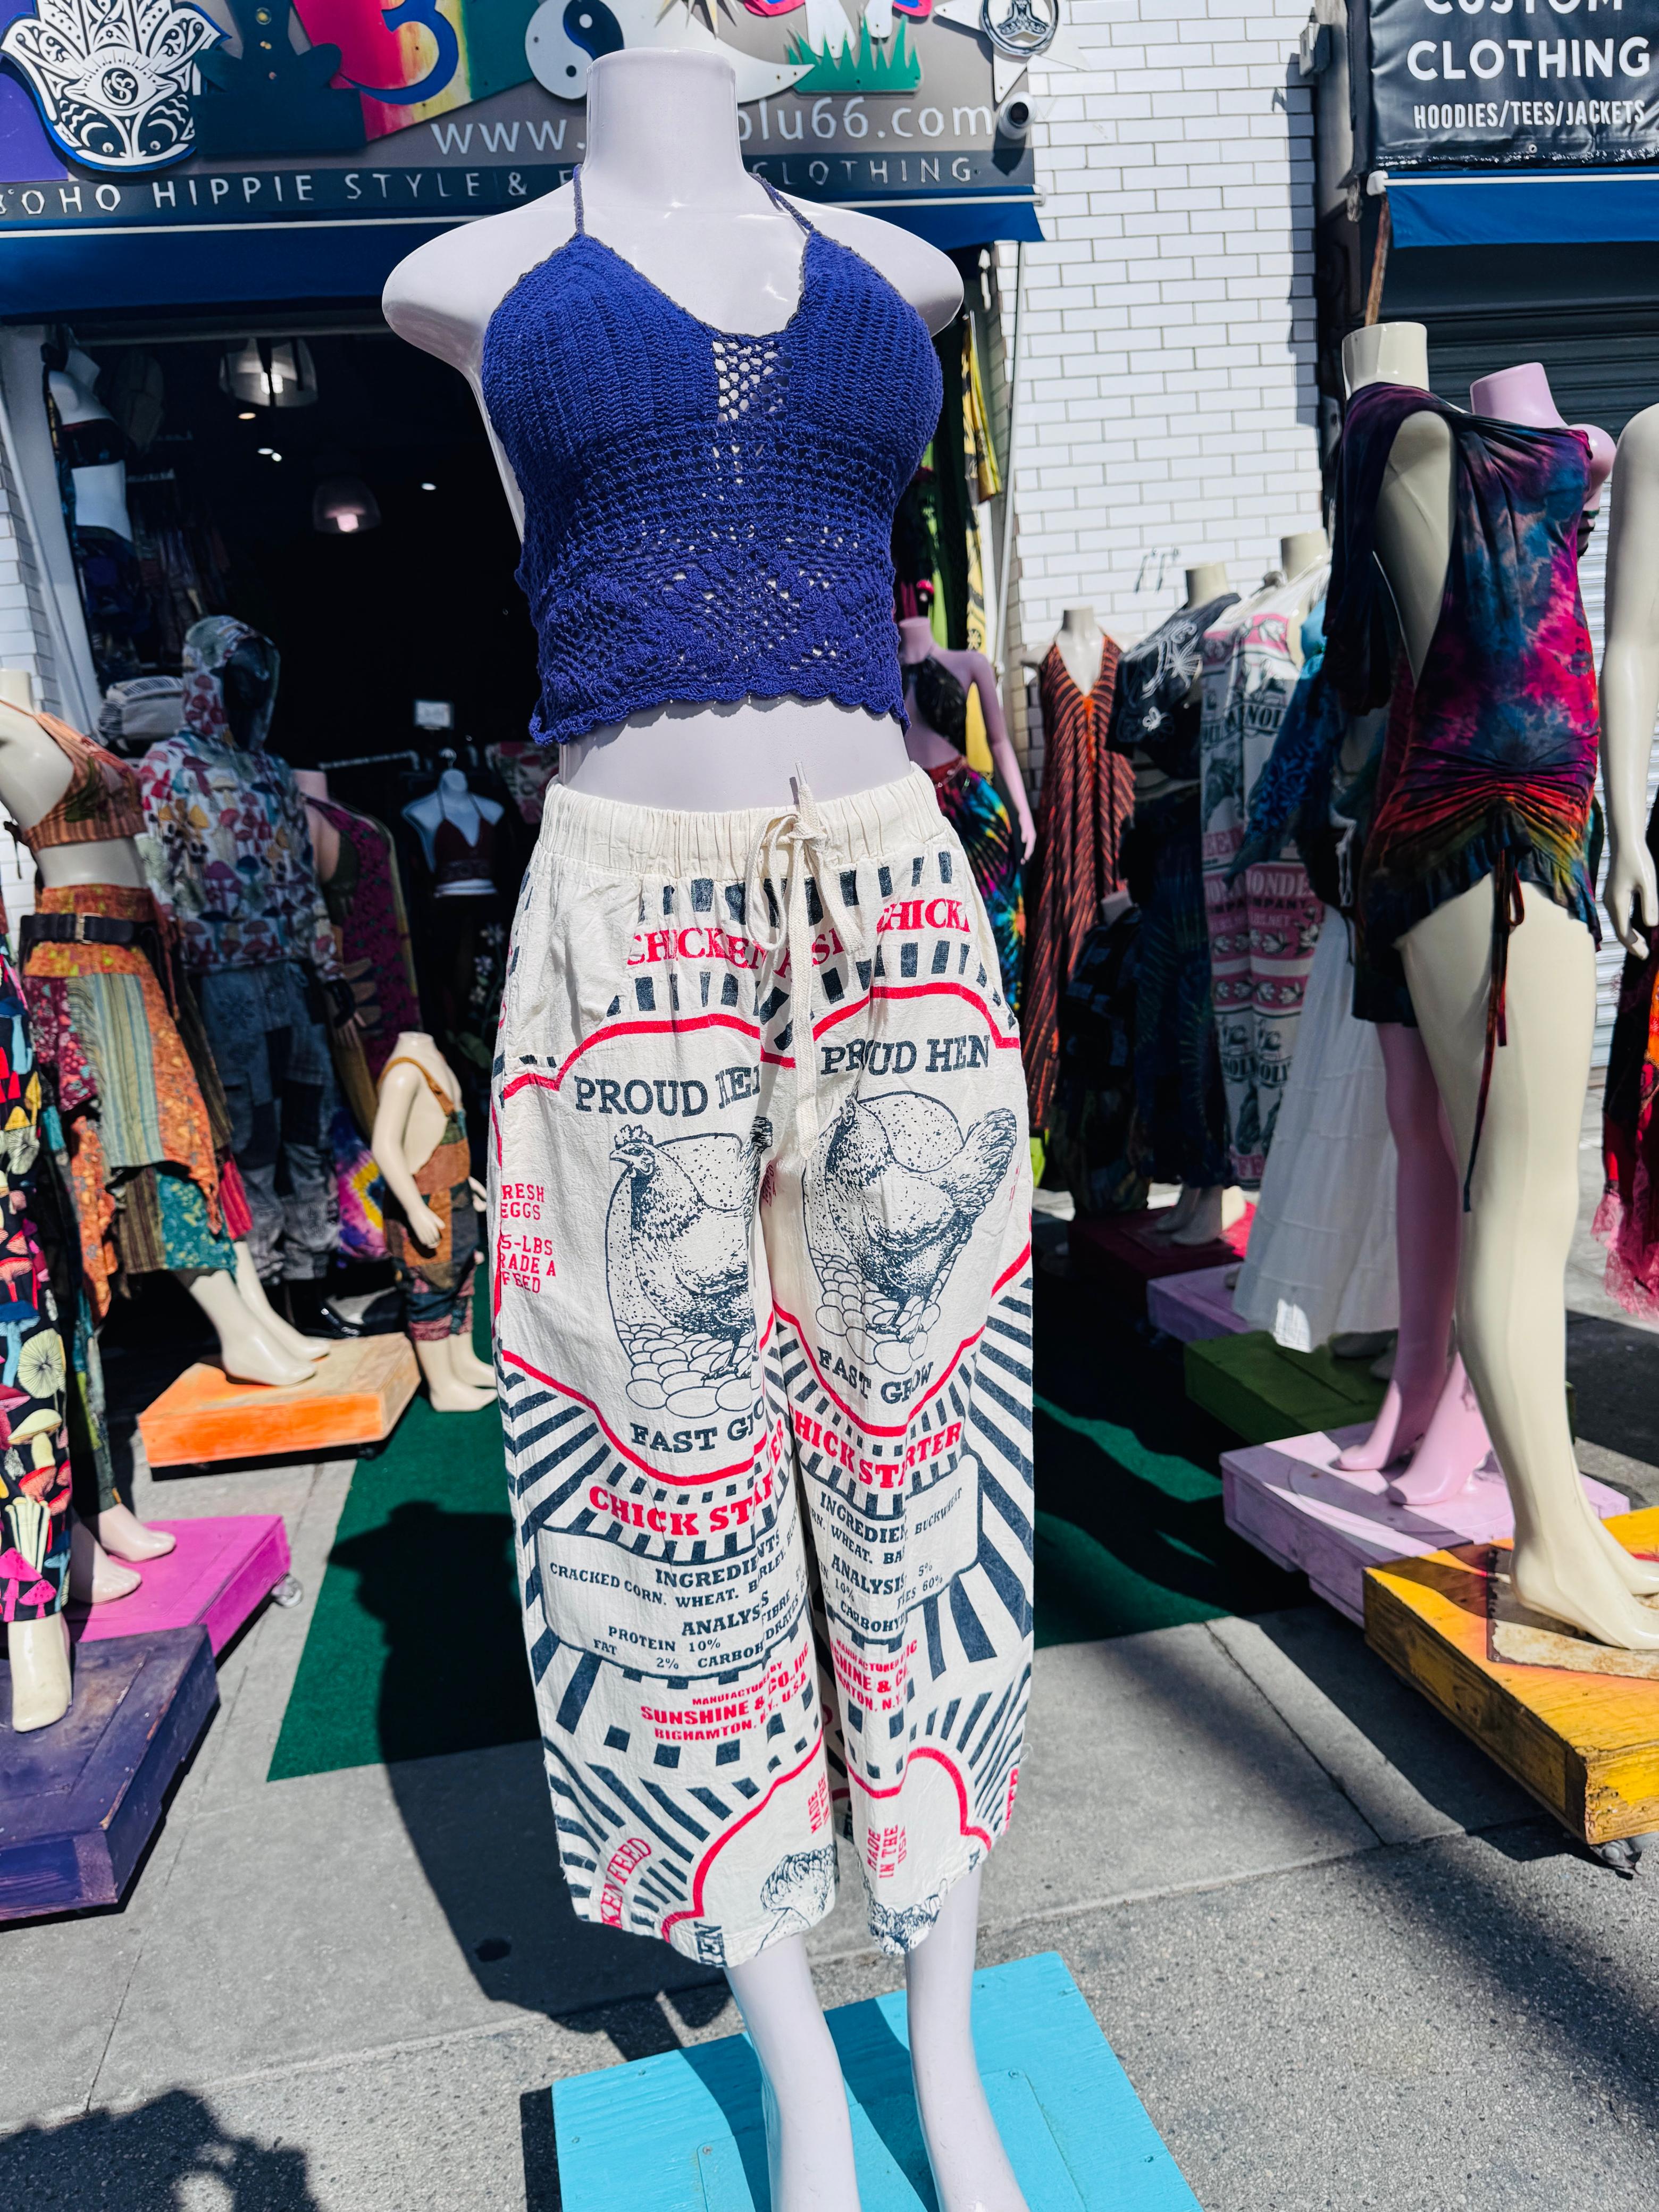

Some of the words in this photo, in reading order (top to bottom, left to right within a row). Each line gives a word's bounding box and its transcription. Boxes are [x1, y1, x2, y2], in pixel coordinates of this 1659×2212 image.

[1407, 36, 1650, 81] CLOTHING
[1413, 99, 1646, 129] HOODIES/TEES/JACKETS
[152, 174, 314, 208] HIPPIE
[344, 172, 480, 199] STYLE
[508, 171, 527, 197] &
[925, 1035, 991, 1073] HEN
[574, 1075, 708, 1117] PROUD
[500, 1202, 541, 1220] EGGS
[501, 1271, 541, 1294] FEED
[546, 1260, 556, 1277] A
[789, 1404, 855, 1474] HICK
[589, 1486, 700, 1536] CHICK
[550, 1562, 621, 1588] CRACKED
[918, 1561, 933, 1577] 5%
[923, 1575, 943, 1591] 60%
[681, 1589, 770, 1637] ANALYSS
[593, 1639, 618, 1656] FAT
[656, 1657, 680, 1670] 2%
[608, 1626, 676, 1652] PROTEIN
[689, 1637, 721, 1653] 10%
[770, 1661, 782, 1673] BY
[877, 1680, 892, 1693] &
[640, 1700, 750, 1725] SUNSHINE
[867, 1825, 881, 1871] MADE
[882, 1824, 898, 1858] THE
[607, 1837, 651, 1886] FEED
[878, 1863, 895, 1879] IN
